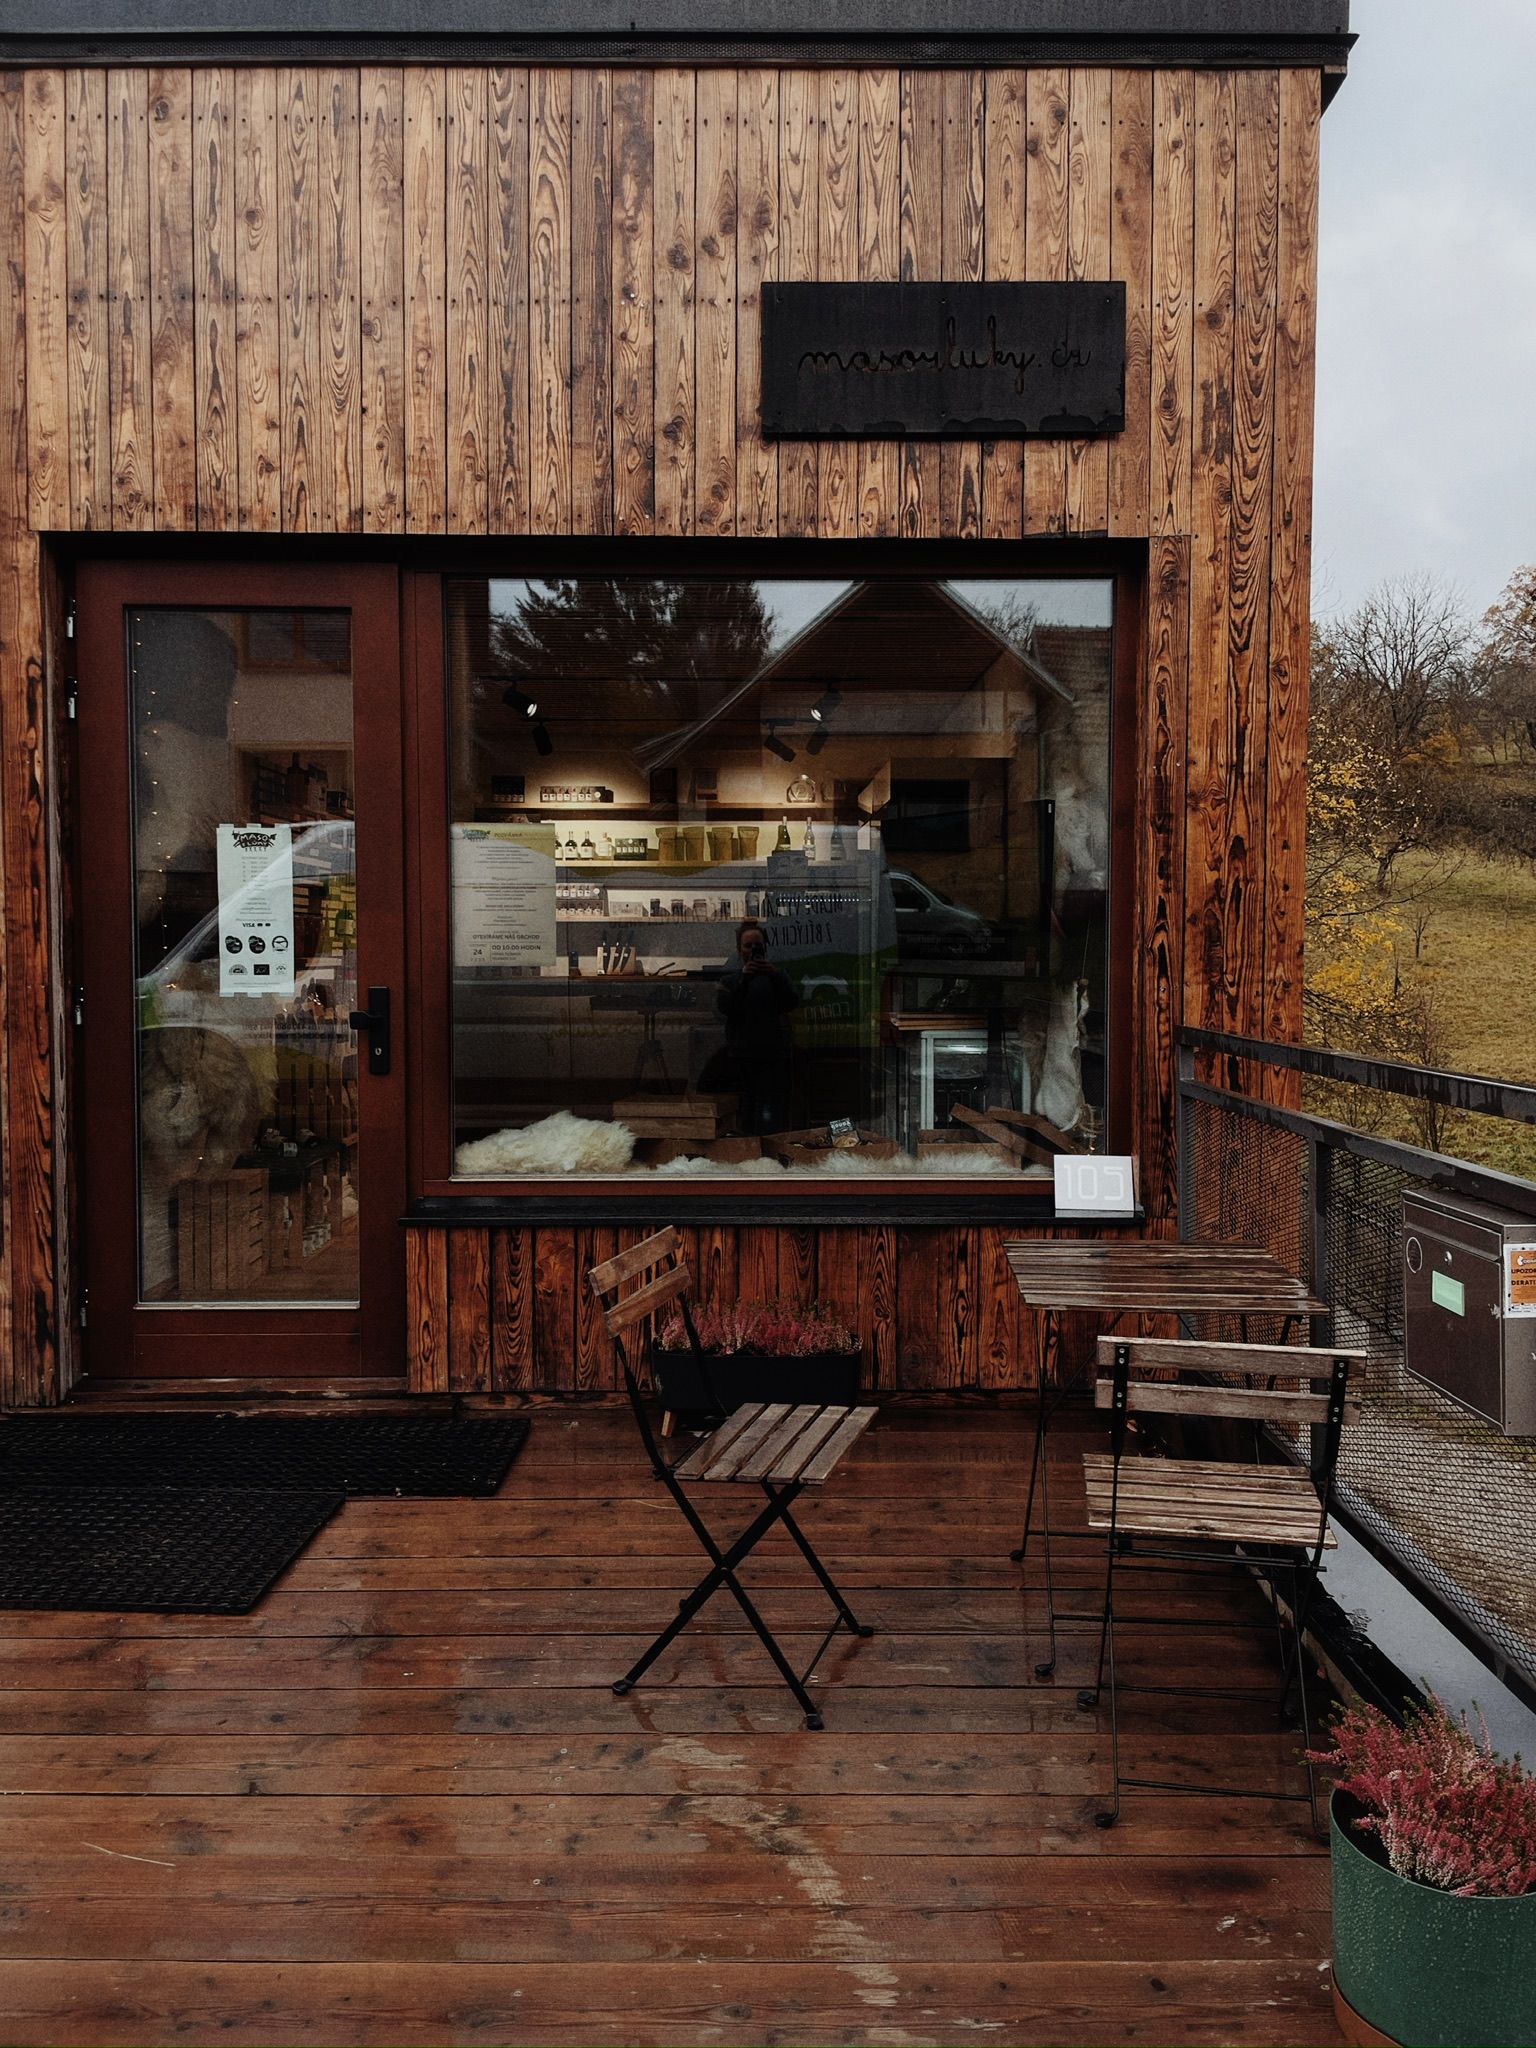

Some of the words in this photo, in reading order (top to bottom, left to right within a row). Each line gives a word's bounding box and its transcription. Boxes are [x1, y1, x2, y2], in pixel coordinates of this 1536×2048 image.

[240, 833, 268, 842] MASO
[504, 932, 516, 940] NÁŠ
[473, 948, 483, 956] 24
[1063, 1165, 1124, 1201] 105
